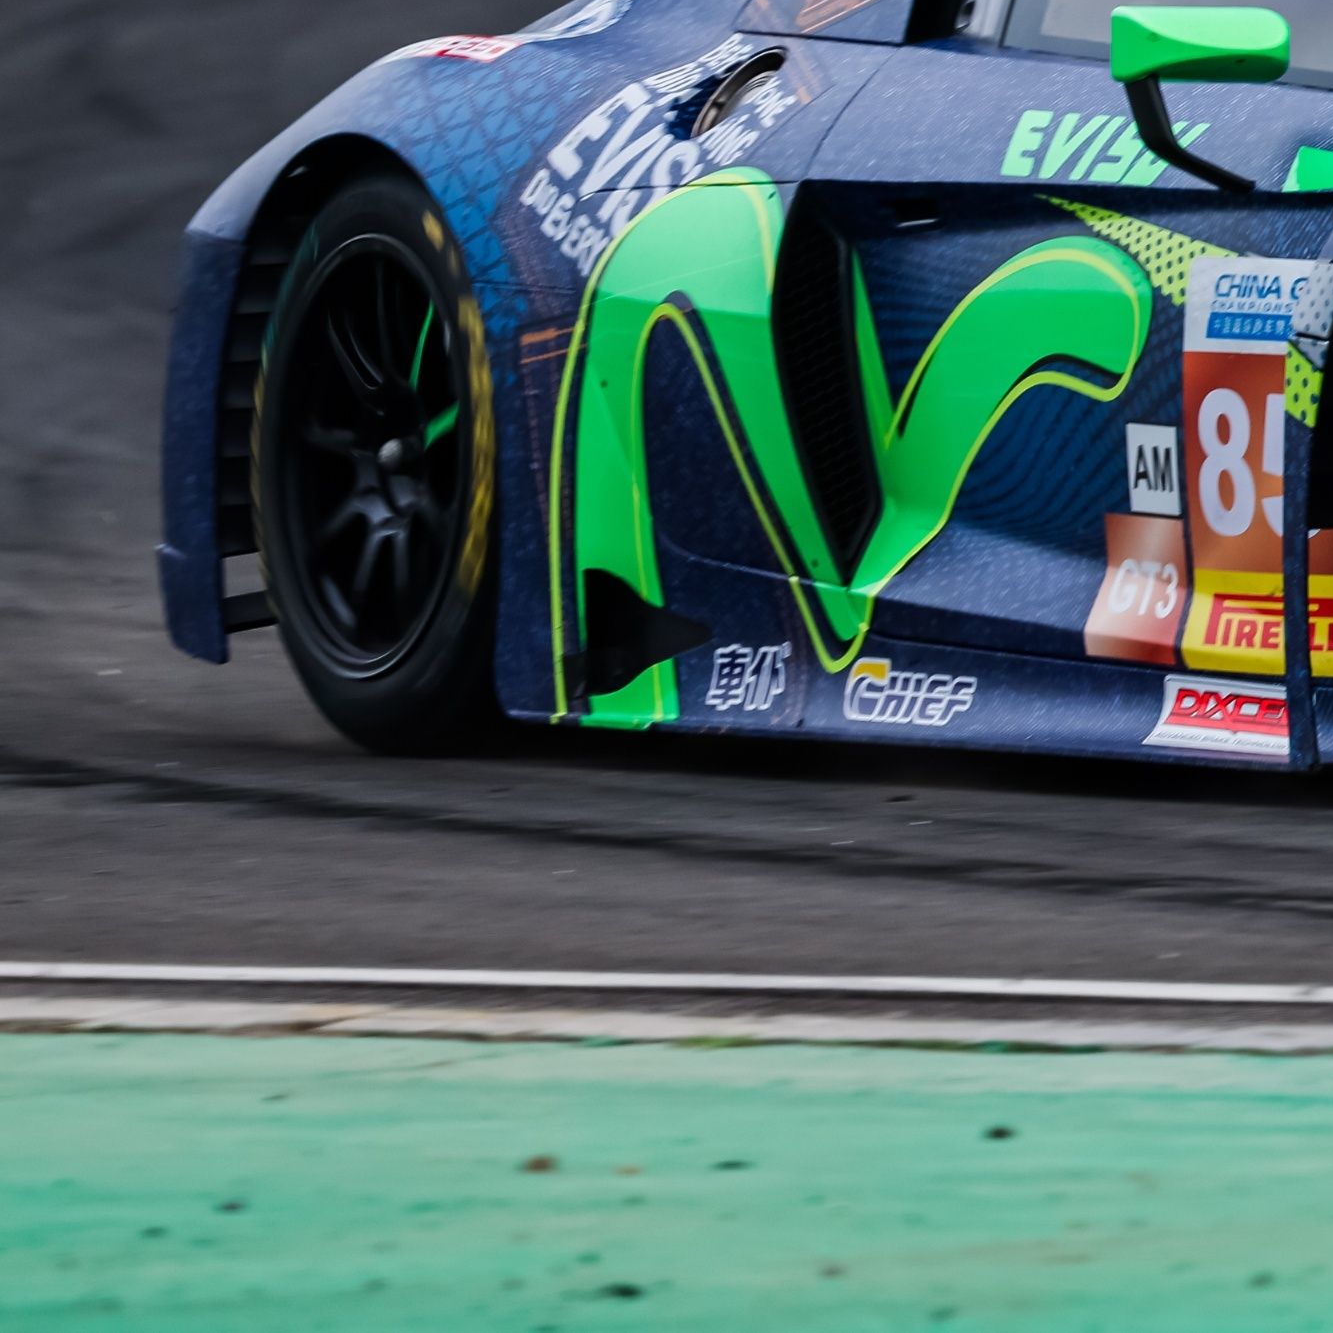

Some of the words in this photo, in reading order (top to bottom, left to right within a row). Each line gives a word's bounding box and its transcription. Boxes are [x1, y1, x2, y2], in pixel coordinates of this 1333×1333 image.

[1215, 273, 1281, 299] CHINA
[1133, 443, 1175, 493] AM
[1107, 558, 1178, 619] GT3
[843, 656, 978, 726] CHIEF
